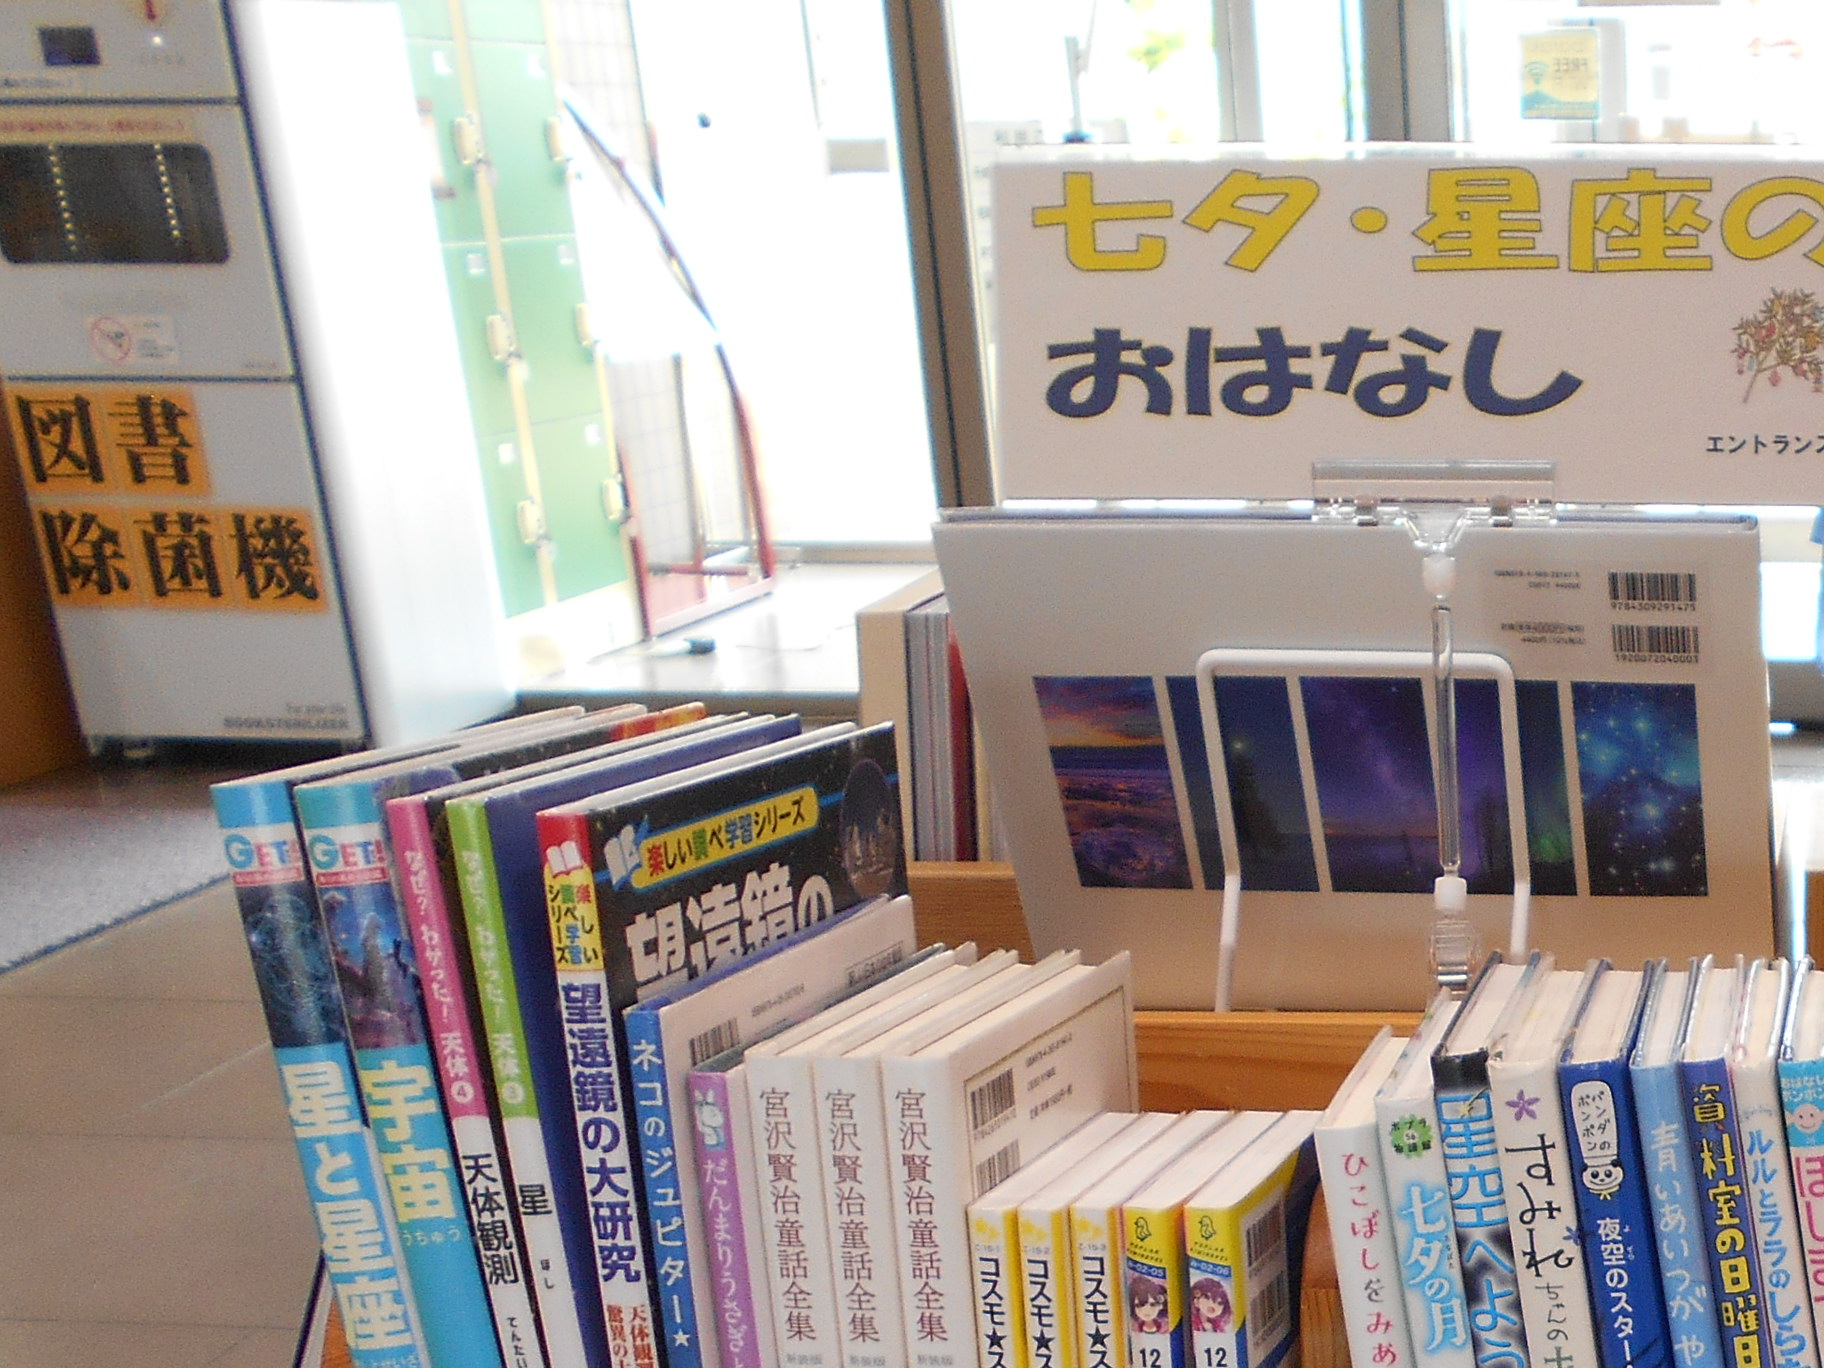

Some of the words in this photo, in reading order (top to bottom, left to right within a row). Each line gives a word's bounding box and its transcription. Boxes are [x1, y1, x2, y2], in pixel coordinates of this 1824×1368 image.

[1045, 326, 1583, 418] おはなし
[18, 394, 196, 487] 図書
[42, 511, 322, 602] 除菌機
[310, 834, 387, 870] GET!
[362, 1059, 458, 1222] 宇宙
[561, 983, 642, 1283] 望遠鏡の大研究
[1576, 1092, 1598, 1153] ポンポン
[1592, 1090, 1611, 1152] パンダの
[281, 1060, 413, 1350] 星と星座
[462, 1152, 519, 1286] 天体観測
[518, 1184, 553, 1216] 星
[760, 1087, 816, 1342] 宮沢賢治童話全集
[826, 1088, 880, 1343] 宮沢賢治童話全集
[895, 1087, 949, 1343] 宮沢賢治童話全集
[1401, 1185, 1468, 1351] 七夕の月
